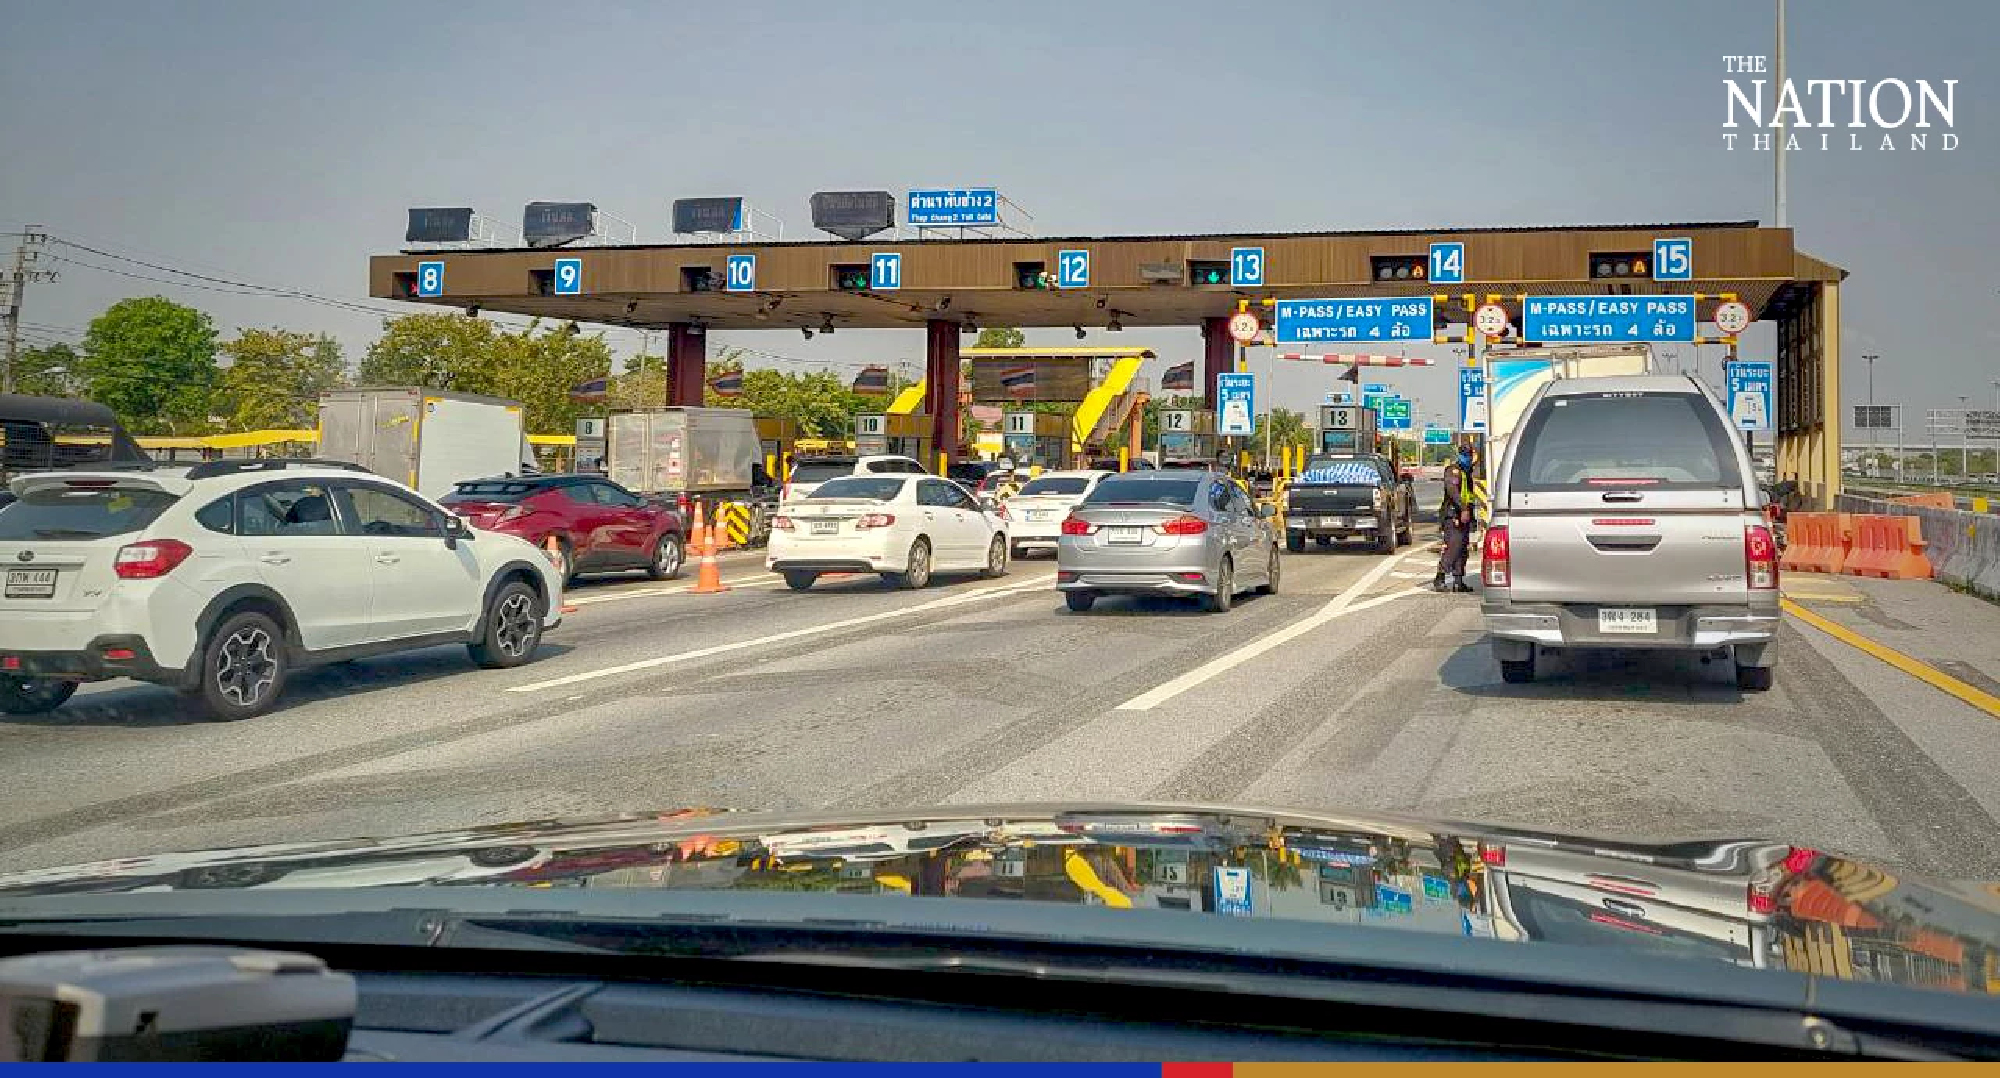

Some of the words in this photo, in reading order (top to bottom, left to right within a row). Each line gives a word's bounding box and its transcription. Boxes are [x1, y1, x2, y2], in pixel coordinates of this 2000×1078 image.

[983, 195, 993, 207] 2
[1235, 254, 1260, 281] 13
[1432, 249, 1462, 278] 14
[1657, 245, 1688, 274] 15
[560, 265, 576, 288] 9
[729, 260, 751, 285] 10
[876, 258, 898, 284] 11
[1061, 256, 1087, 281] 12
[424, 268, 437, 291] 8
[1392, 304, 1426, 317] PASS
[1647, 302, 1687, 315] PASS
[1369, 327, 1380, 337] 4
[1391, 321, 1410, 337] ล้อ
[1628, 324, 1638, 337] 4
[1653, 318, 1676, 337] ล้อ
[1463, 384, 1471, 396] 5
[1732, 378, 1740, 392] 5
[1011, 416, 1024, 431] 11
[1166, 413, 1182, 429] 12
[1330, 410, 1348, 426] 13
